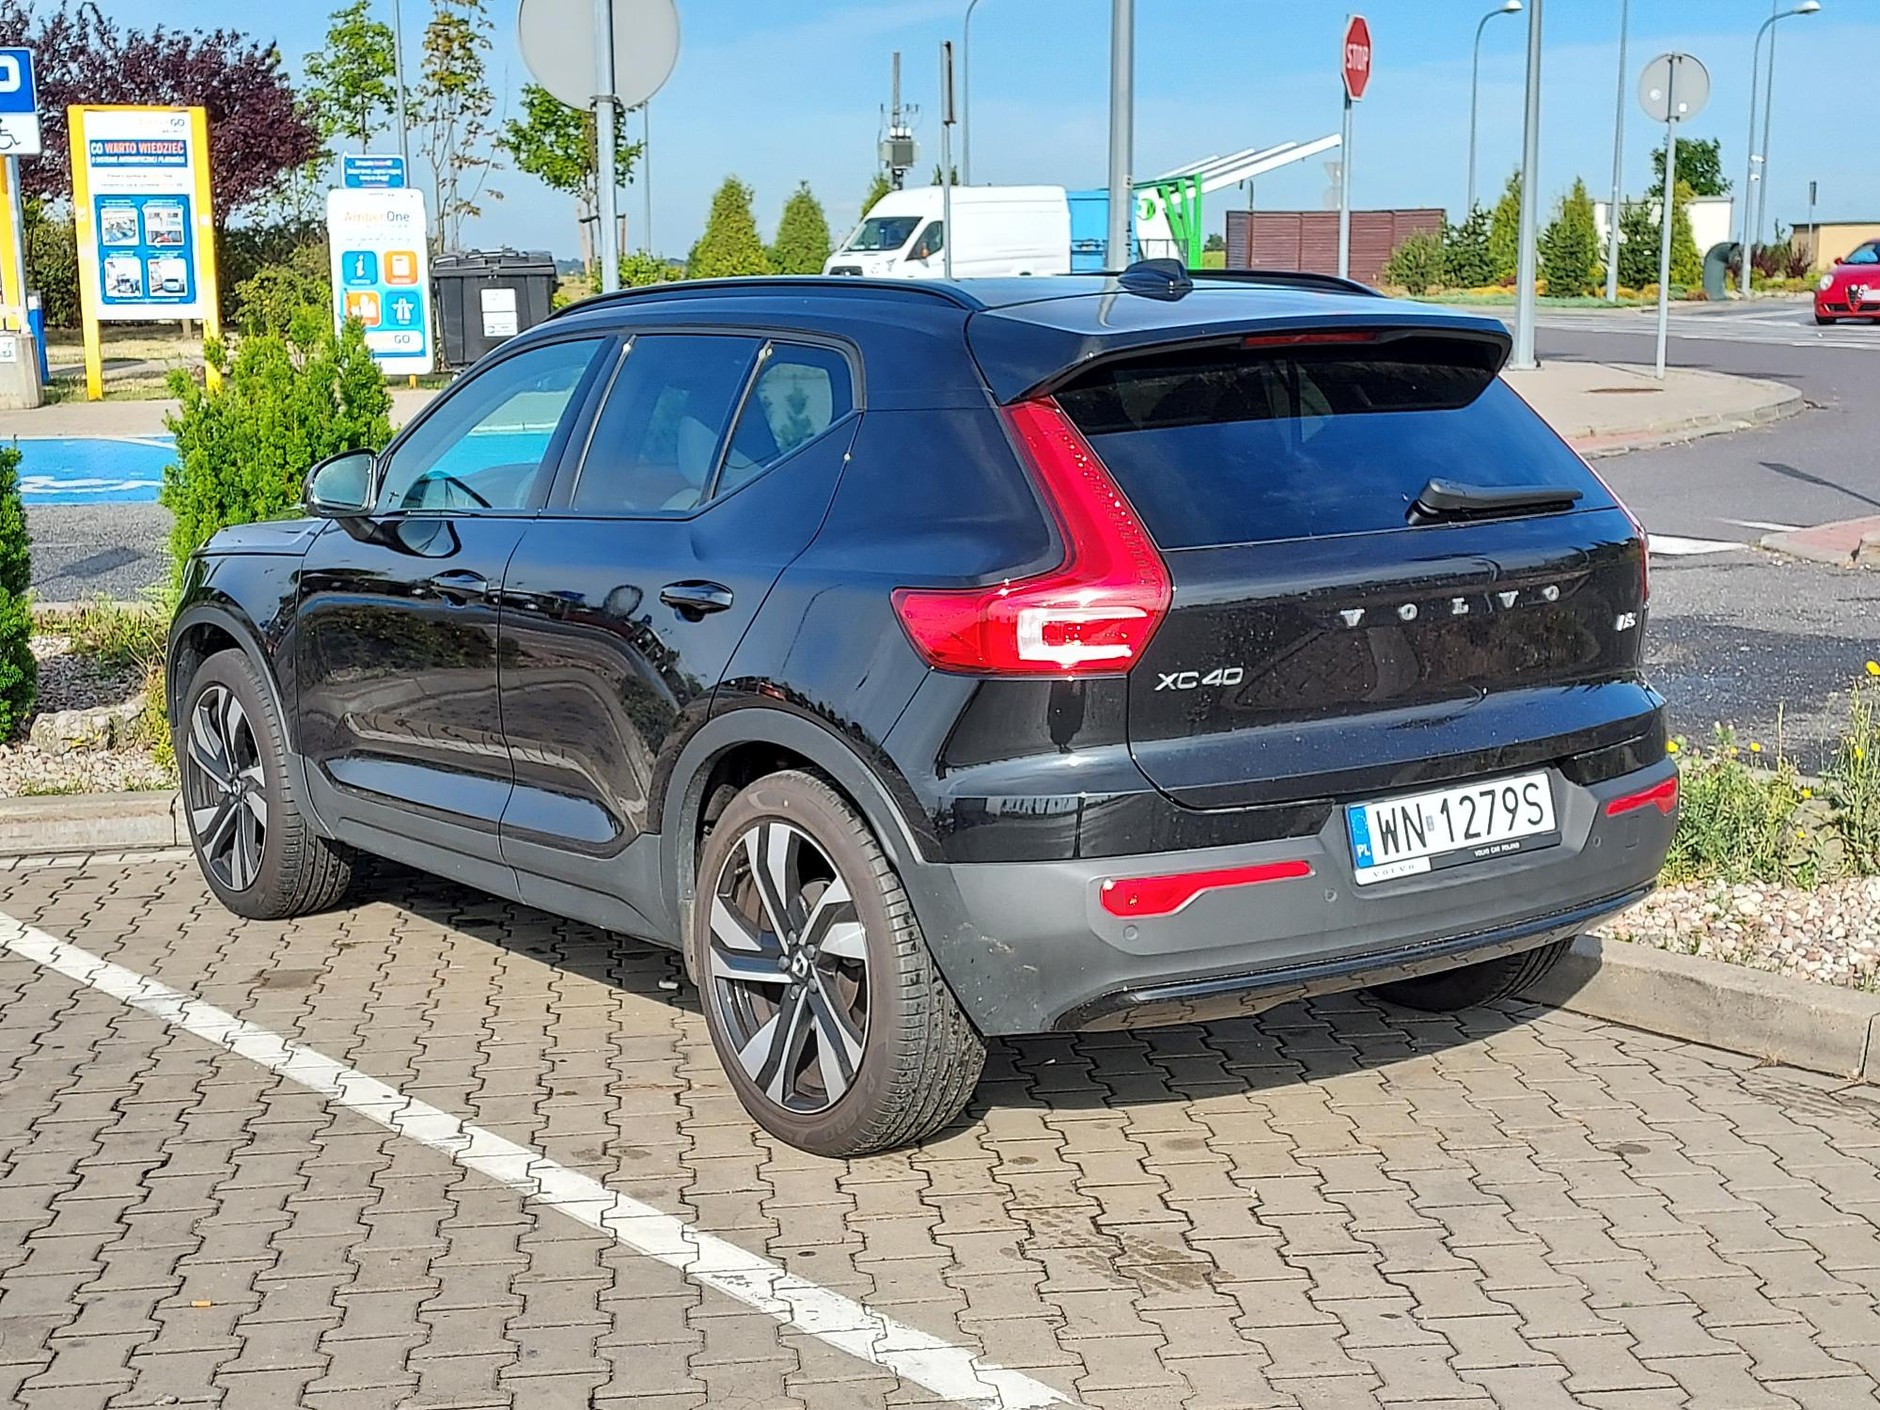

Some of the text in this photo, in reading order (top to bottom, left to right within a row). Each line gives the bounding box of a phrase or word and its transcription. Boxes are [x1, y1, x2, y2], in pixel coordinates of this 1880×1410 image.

[1346, 43, 1369, 72] STOP
[91, 142, 103, 155] CO
[105, 141, 137, 155] WARTO
[1339, 584, 1560, 627] VOLVO
[1154, 666, 1244, 691] XC40
[1376, 782, 1544, 856] WN 1279S
[1356, 844, 1371, 858] PL
[1373, 864, 1415, 878] VOLVO
